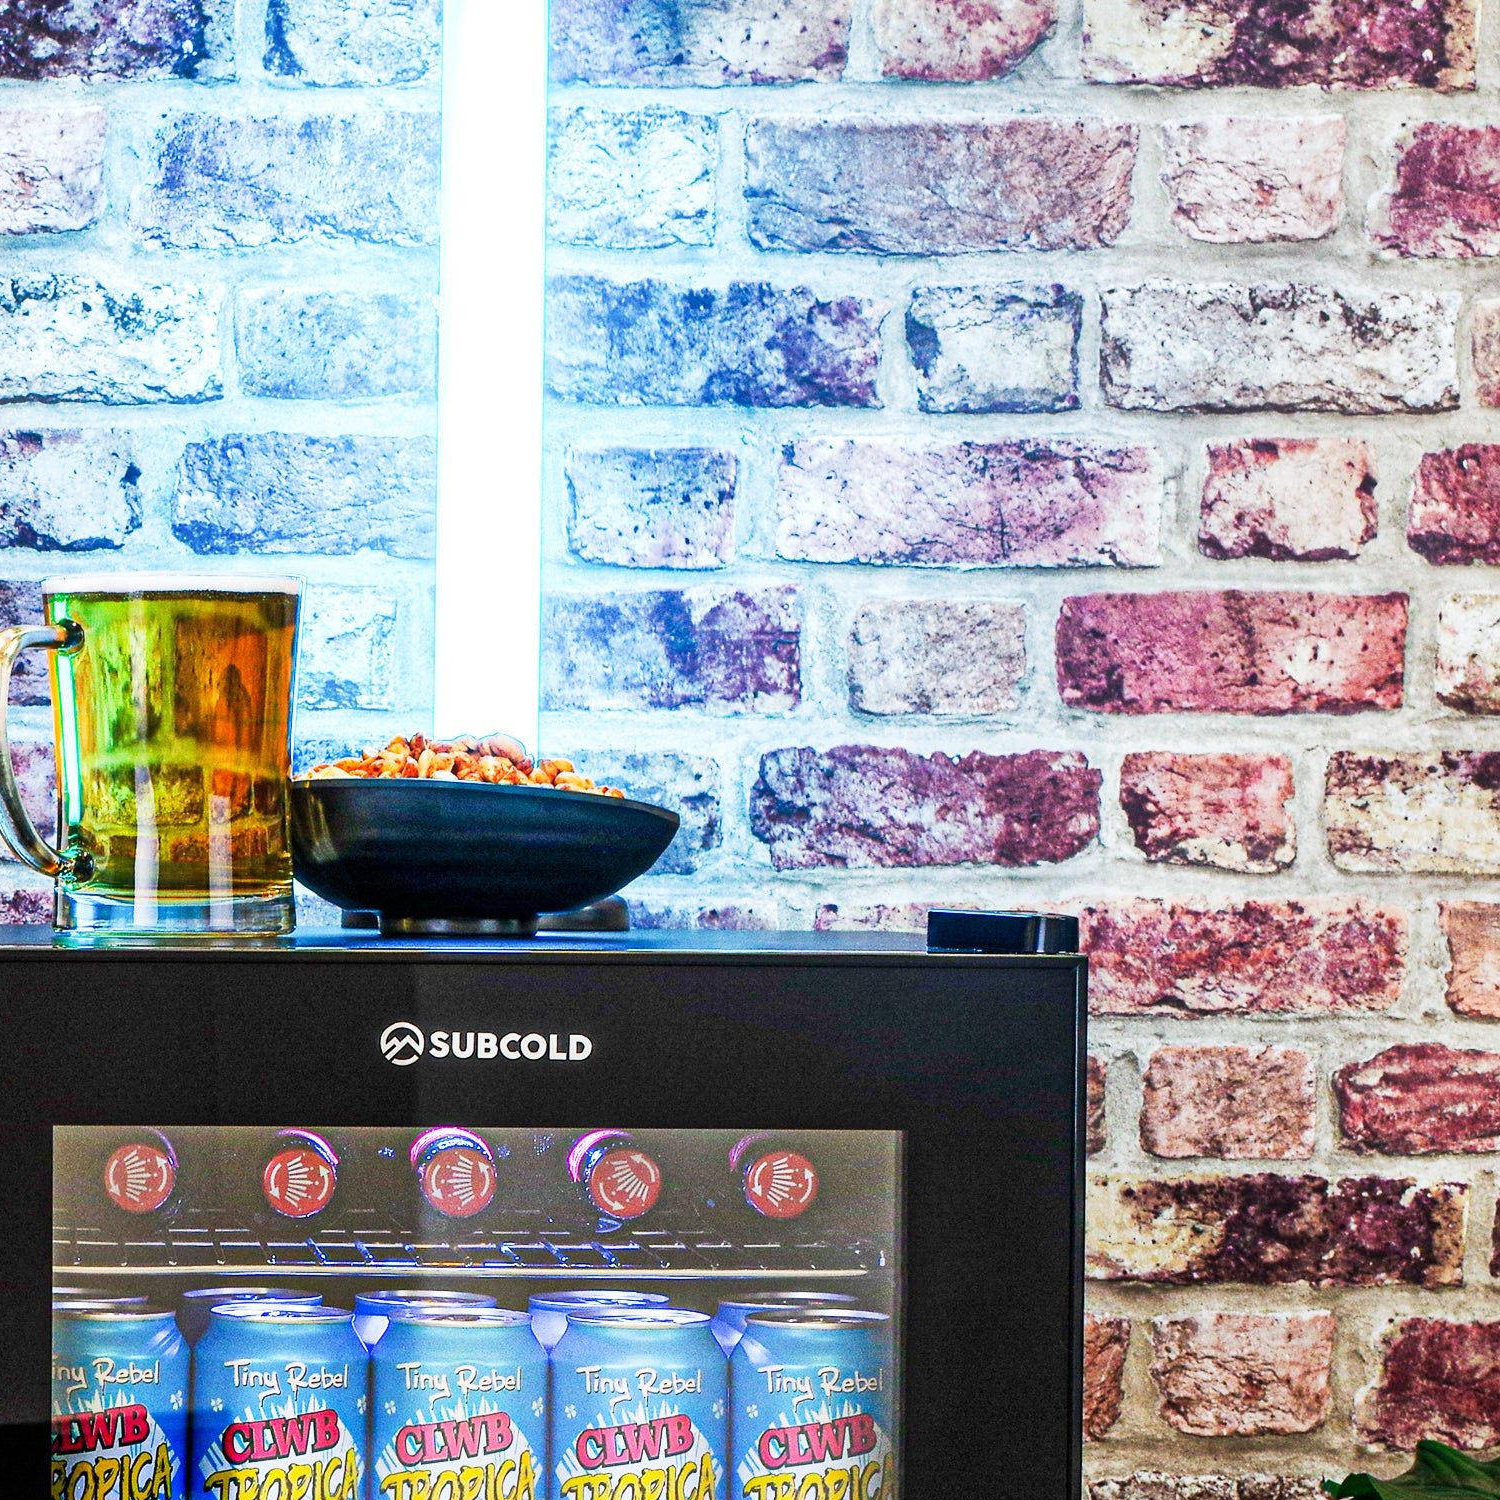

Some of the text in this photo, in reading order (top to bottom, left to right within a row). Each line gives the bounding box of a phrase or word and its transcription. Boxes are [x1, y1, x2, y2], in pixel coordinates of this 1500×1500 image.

[428, 1030, 593, 1061] SUBCOLD
[52, 1353, 159, 1401] iny Rebel
[224, 1359, 349, 1407] Tiny Rebel
[396, 1361, 522, 1410] Tiny Rebel
[576, 1366, 702, 1414] Tiny Rebel
[758, 1364, 883, 1413] Tiny Rebel
[52, 1403, 150, 1456] LWB
[222, 1409, 341, 1466] CLWB
[396, 1411, 513, 1467] CLWB
[576, 1413, 693, 1470] CLWB
[758, 1413, 877, 1470] CLWB
